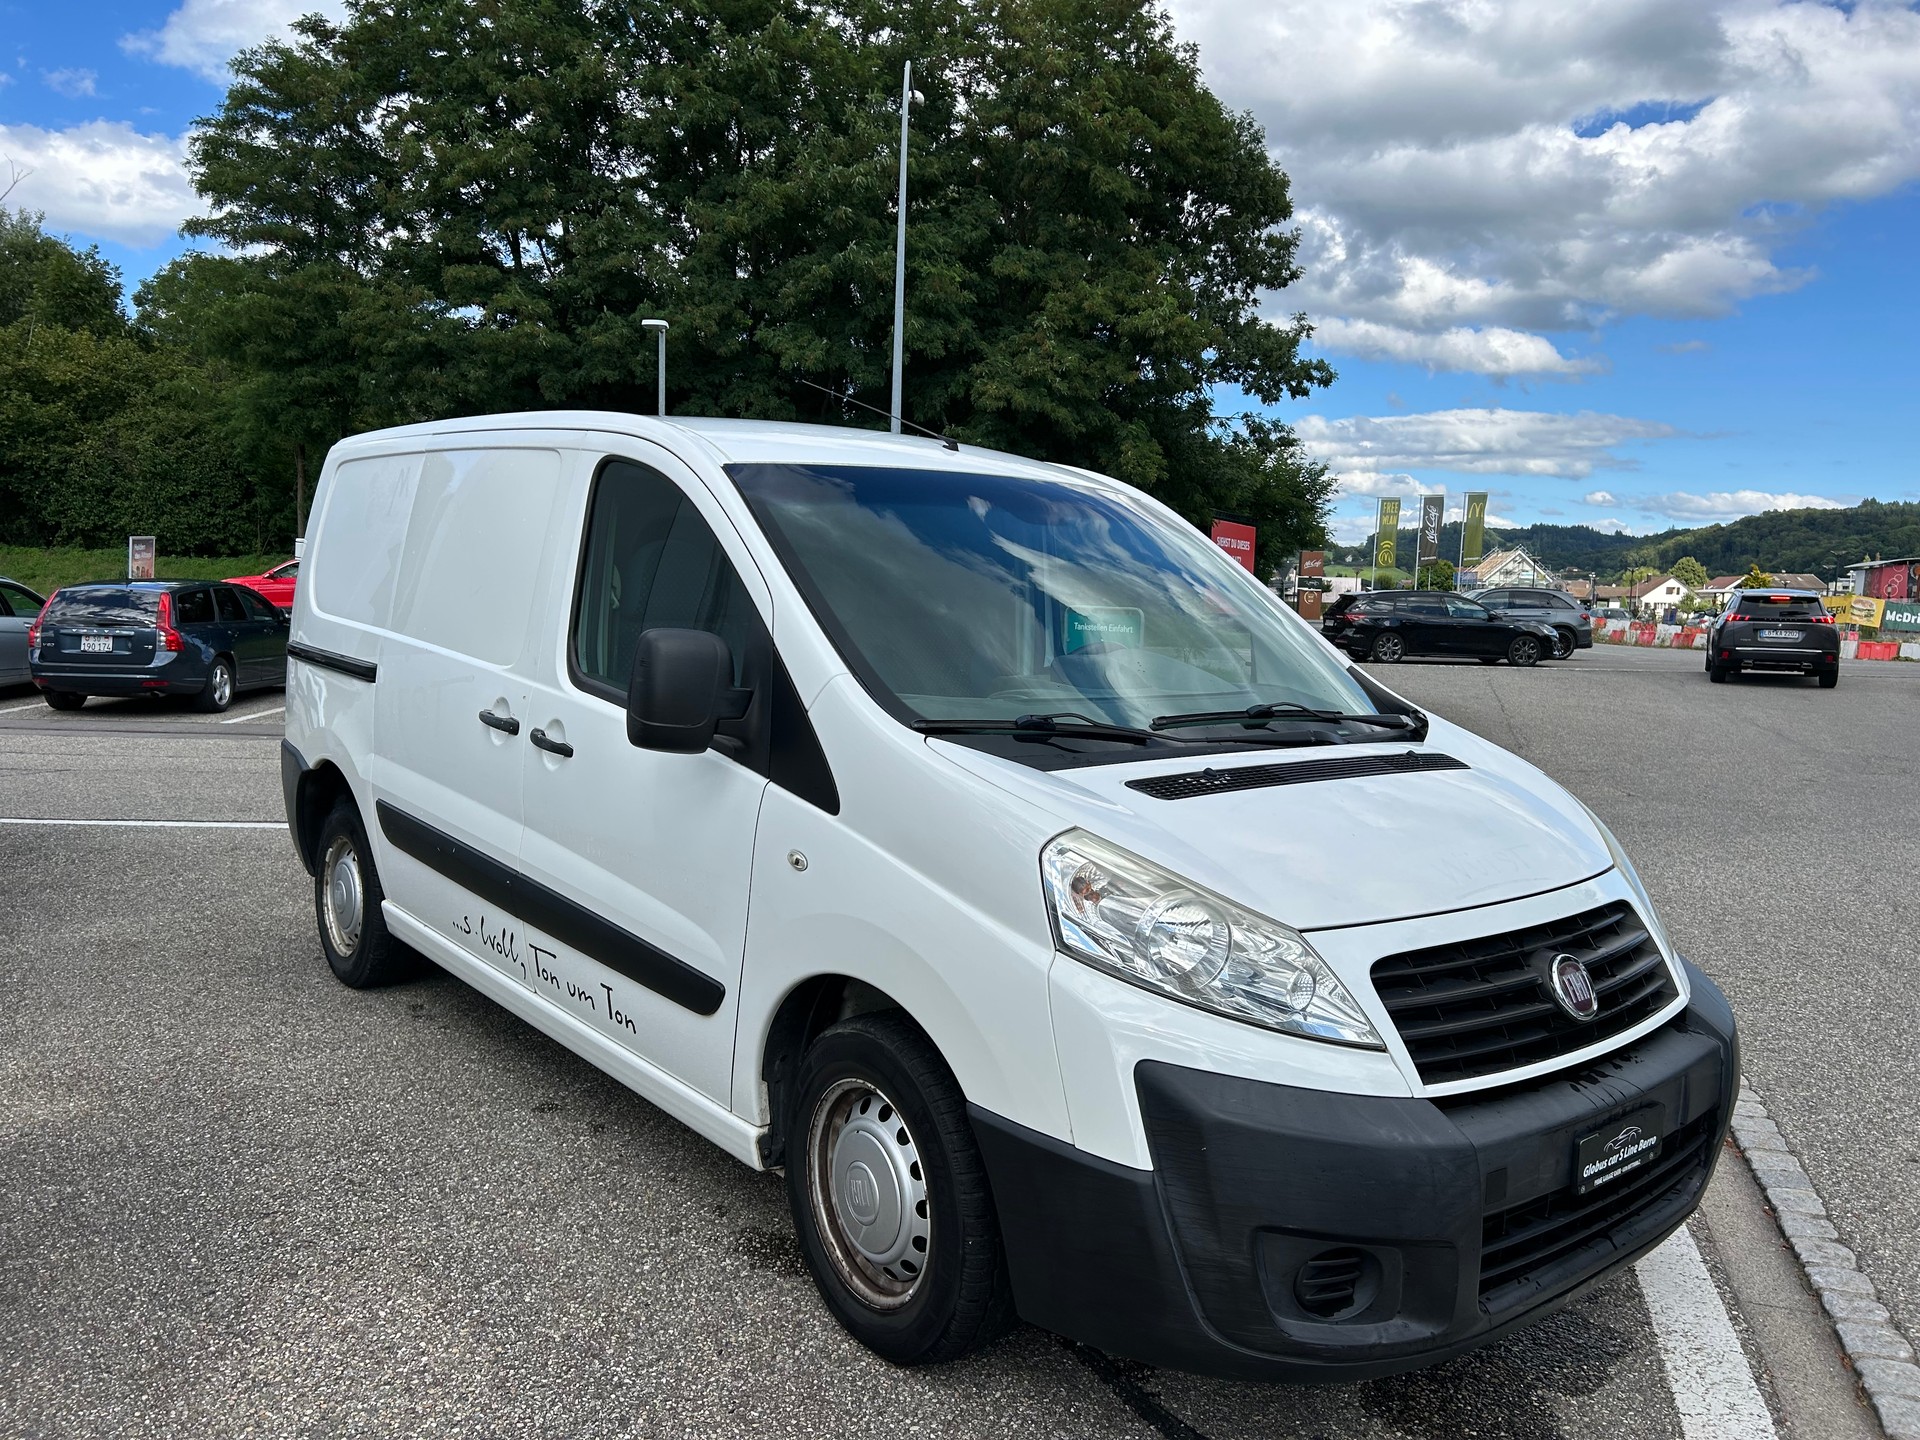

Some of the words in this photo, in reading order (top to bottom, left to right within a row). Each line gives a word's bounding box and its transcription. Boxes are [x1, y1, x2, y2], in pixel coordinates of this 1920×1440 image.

[1383, 502, 1398, 514] FREE
[1382, 514, 1397, 526] WLAN
[1231, 538, 1237, 549] DU
[1237, 540, 1250, 551] DIESES
[1074, 622, 1107, 631] Tankstellen
[1108, 624, 1133, 633] Einfahrt
[82, 642, 96, 651] 190
[98, 642, 111, 651] 174
[528, 943, 561, 990] Ton
[566, 981, 596, 1011] um
[600, 982, 637, 1035] Ton
[1583, 1159, 1608, 1178] Globus
[1607, 1153, 1620, 1167] car
[1624, 1144, 1639, 1159] Line
[1638, 1135, 1657, 1152] Berro
